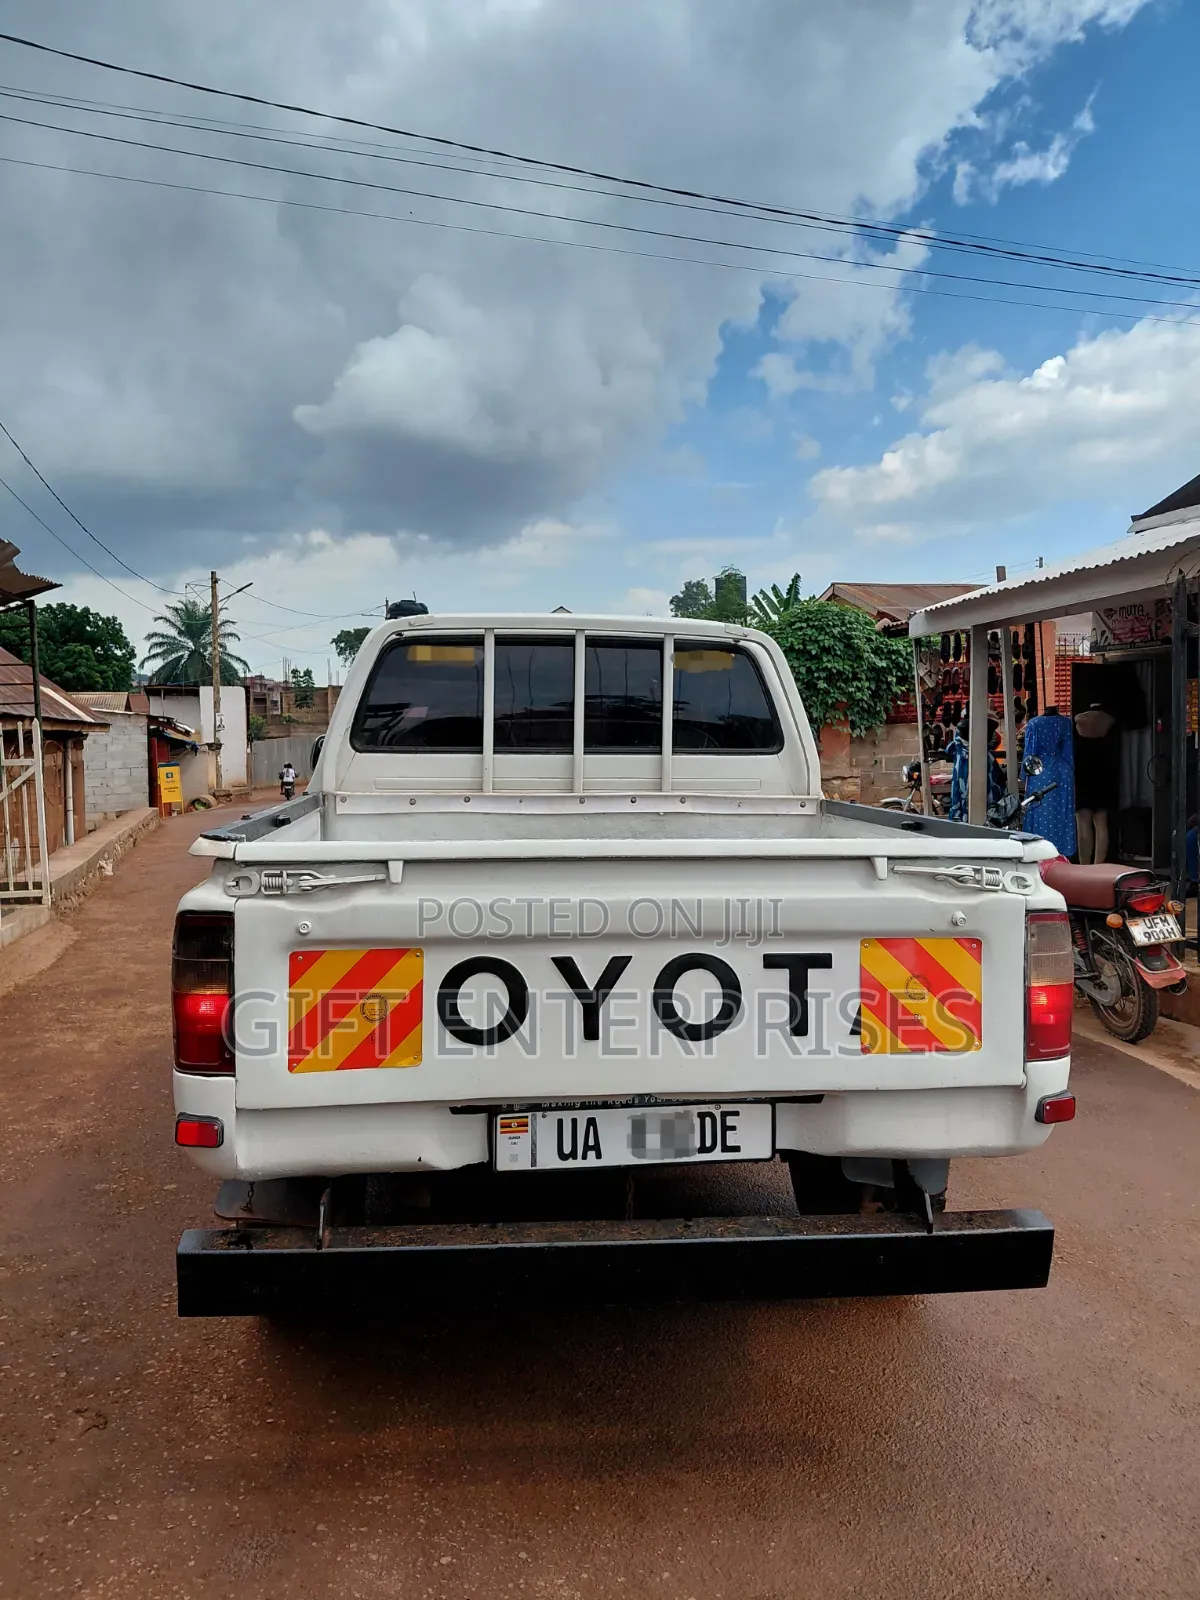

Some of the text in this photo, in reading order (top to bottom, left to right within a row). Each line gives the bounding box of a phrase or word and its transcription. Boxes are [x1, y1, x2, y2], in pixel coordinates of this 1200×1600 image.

[1143, 916, 1170, 929] UFM
[437, 952, 861, 1046] OYOT
[556, 1116, 602, 1161] UA
